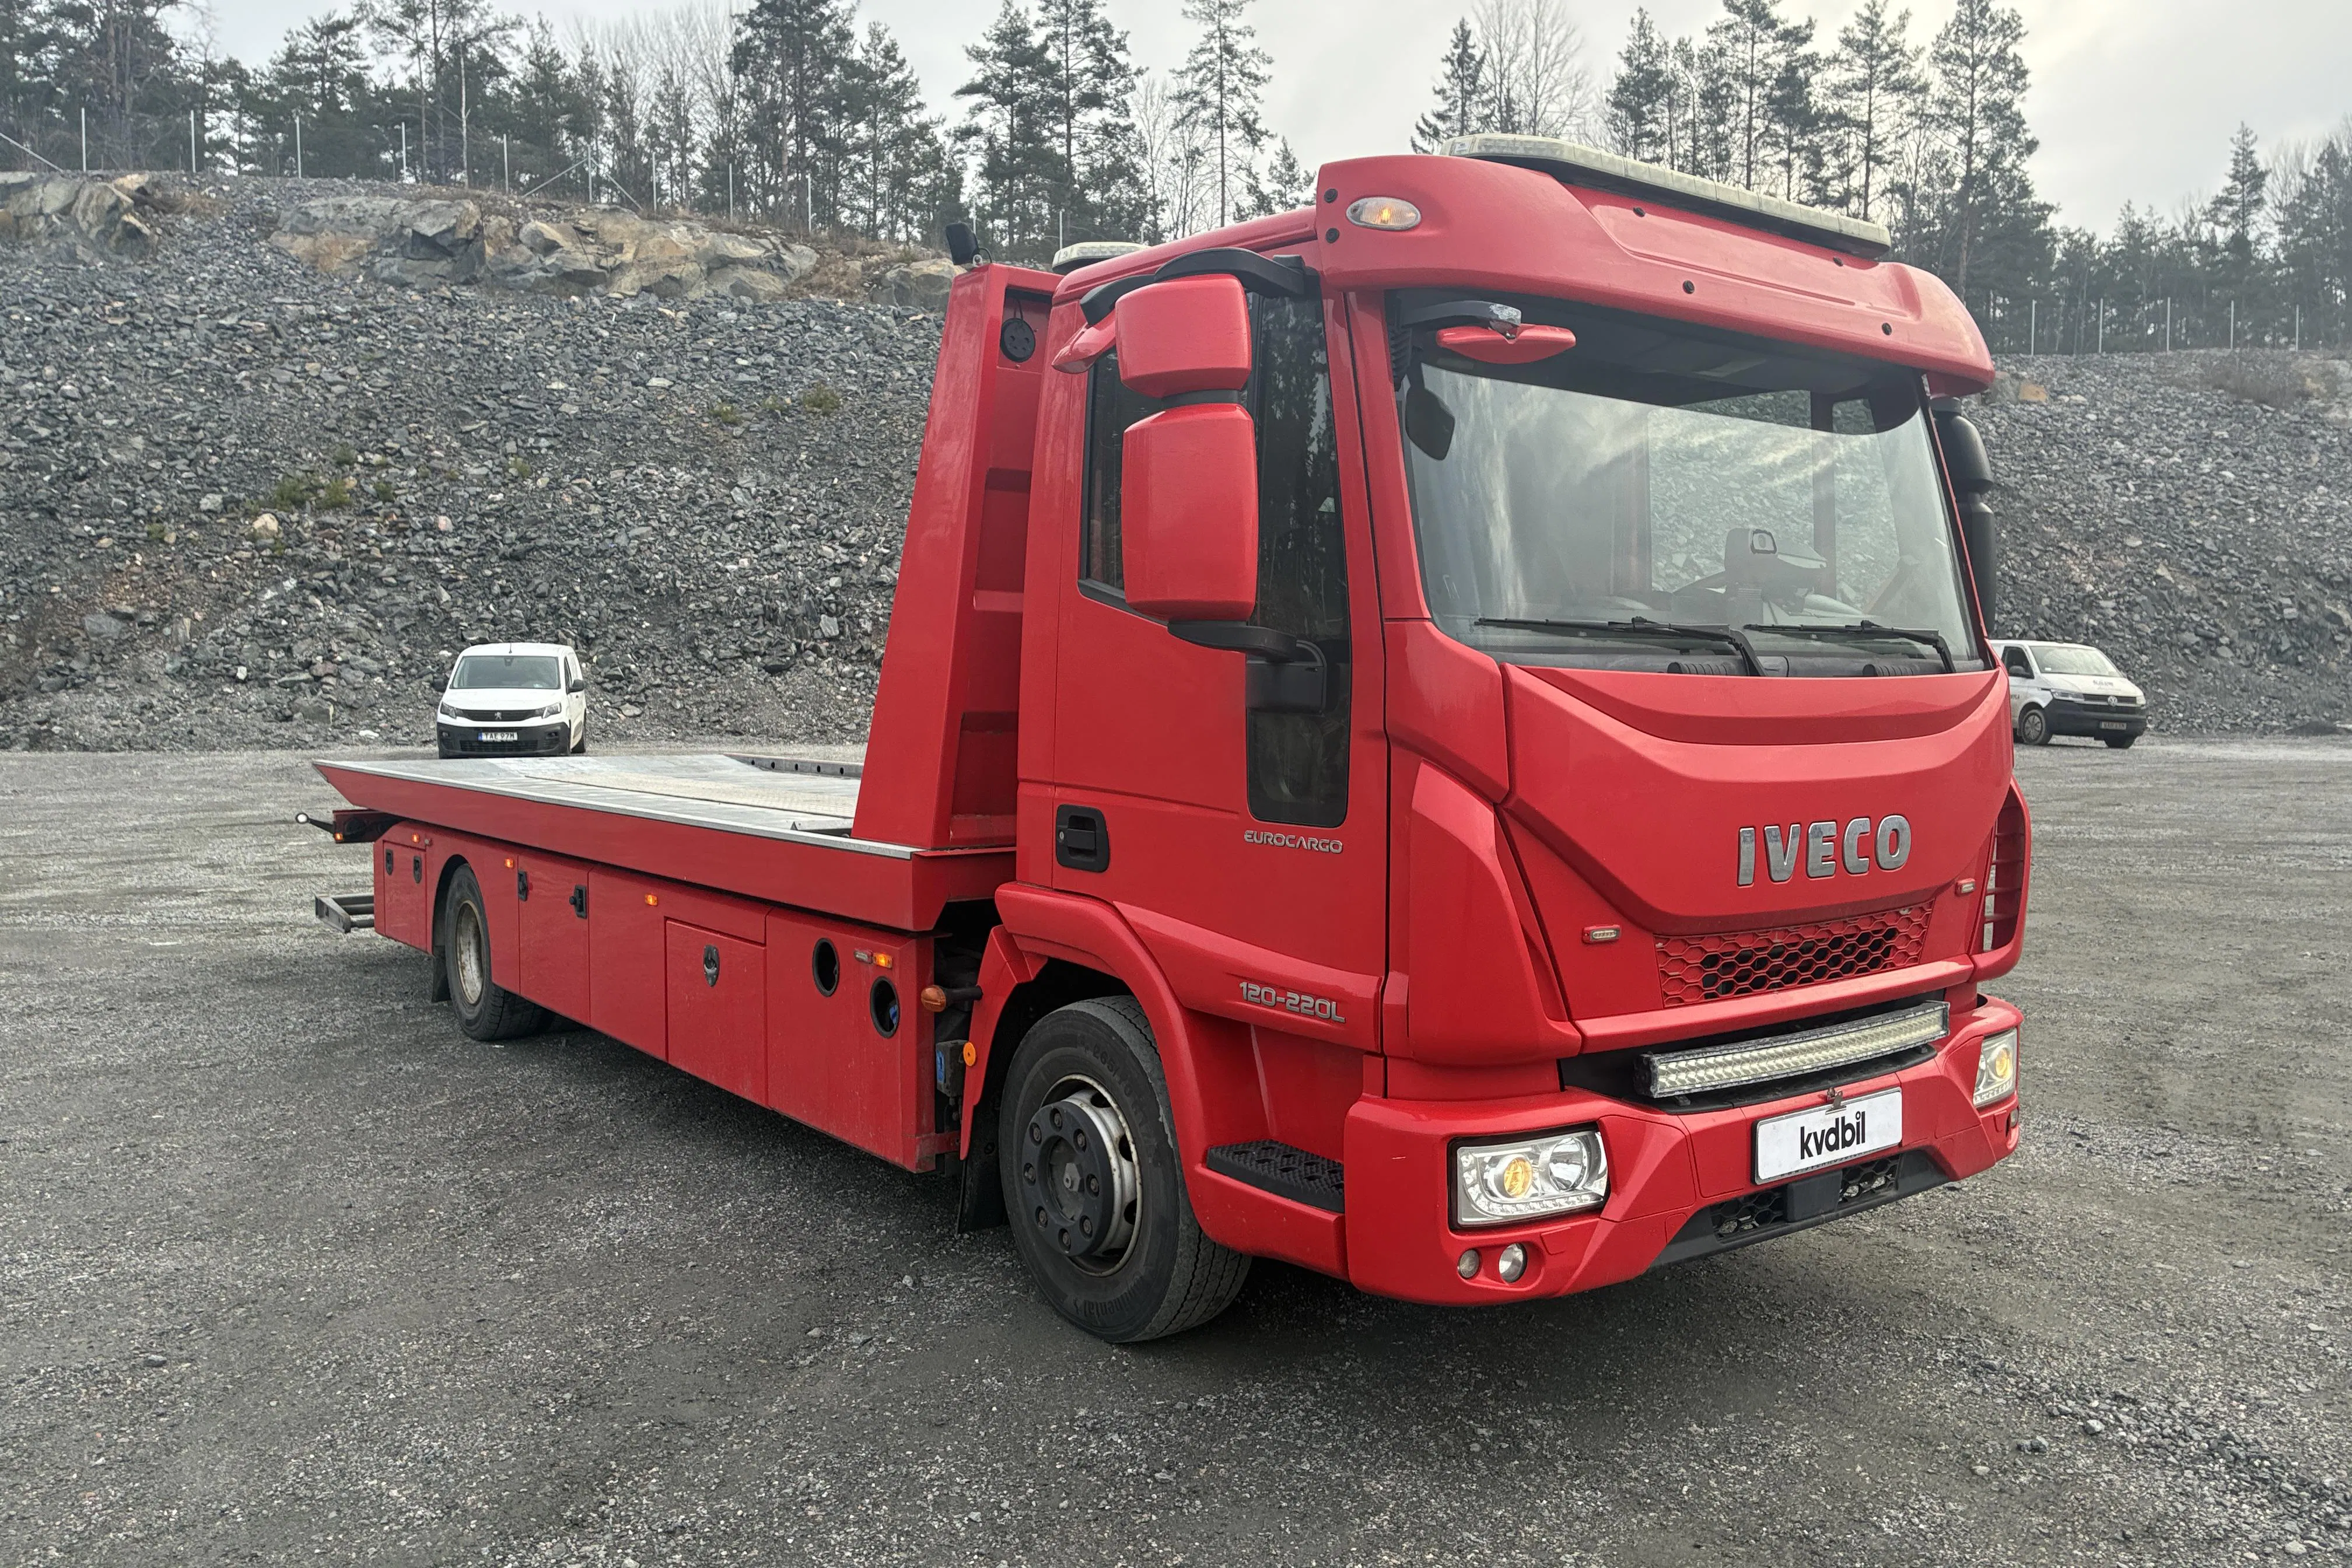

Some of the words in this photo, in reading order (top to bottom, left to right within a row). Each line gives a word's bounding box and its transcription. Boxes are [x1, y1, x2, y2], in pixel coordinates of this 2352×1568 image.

[1244, 830, 1343, 853] EUROCARGO
[1737, 814, 1912, 887] IVECO
[1240, 981, 1346, 1023] 120-220L
[1800, 1111, 1866, 1160] kvdbil
